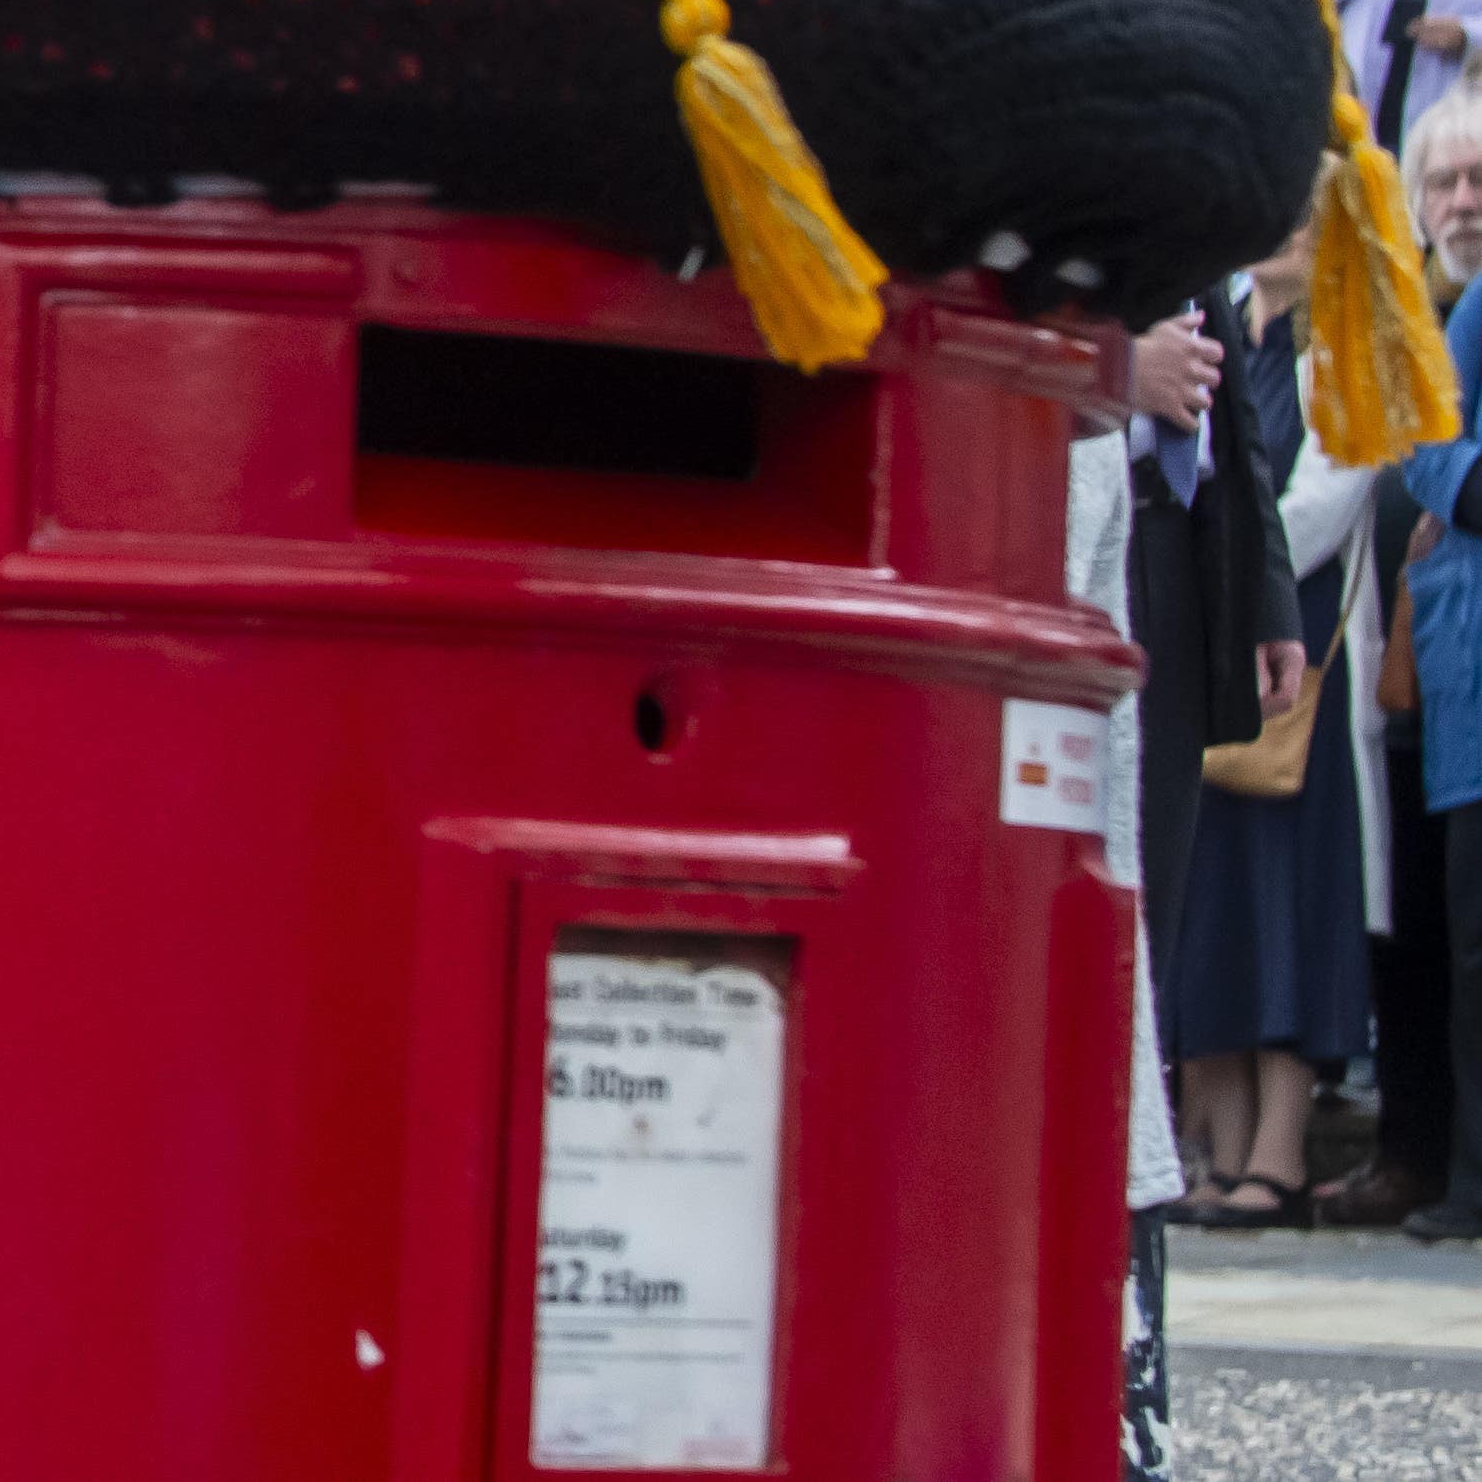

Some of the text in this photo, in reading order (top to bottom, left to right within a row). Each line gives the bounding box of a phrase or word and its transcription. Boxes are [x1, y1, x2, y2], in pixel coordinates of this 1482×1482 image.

[552, 1021, 617, 1049] onday
[657, 1021, 727, 1055] Friday
[540, 1227, 626, 1257] aturday
